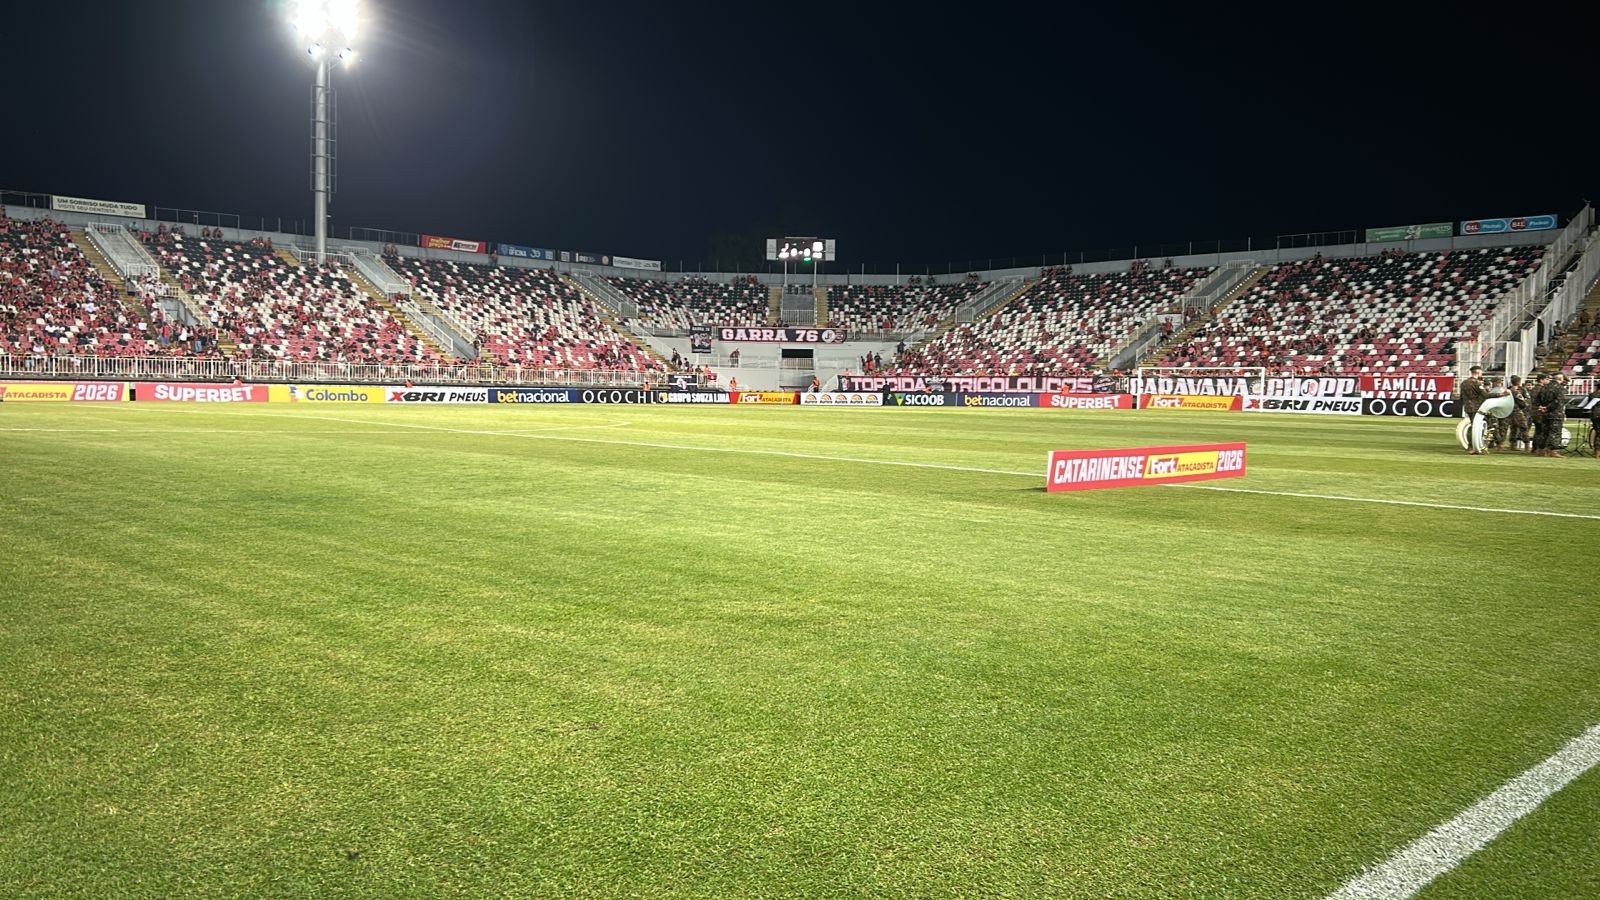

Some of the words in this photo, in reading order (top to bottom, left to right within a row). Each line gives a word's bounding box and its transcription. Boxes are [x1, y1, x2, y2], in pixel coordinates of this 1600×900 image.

[721, 329, 788, 342] GARRA
[795, 330, 820, 342] 76
[851, 377, 927, 393] TORCIDA
[1373, 375, 1437, 392] FAMÍLIA
[4, 392, 68, 401] ATACADISTA
[73, 383, 119, 401] 2026
[154, 384, 254, 403] SUPERBET
[306, 389, 369, 402] Colombo
[449, 393, 488, 402] PNEUS
[497, 390, 570, 404] betnacional
[668, 392, 691, 403] GRUPO
[691, 392, 713, 403] SOUZA
[714, 393, 730, 403] LIMA
[742, 394, 762, 403] Fort
[904, 394, 944, 406] SICOOB
[964, 394, 1031, 407] betnacional
[1050, 394, 1121, 409] SUPERBET
[1153, 397, 1183, 408] Fort
[1312, 400, 1361, 412] PNEUS
[1053, 456, 1146, 484] CATARINENSE
[1150, 457, 1179, 475] Fort
[1177, 462, 1214, 472] ATACADISTA
[1216, 450, 1243, 472] 2026
